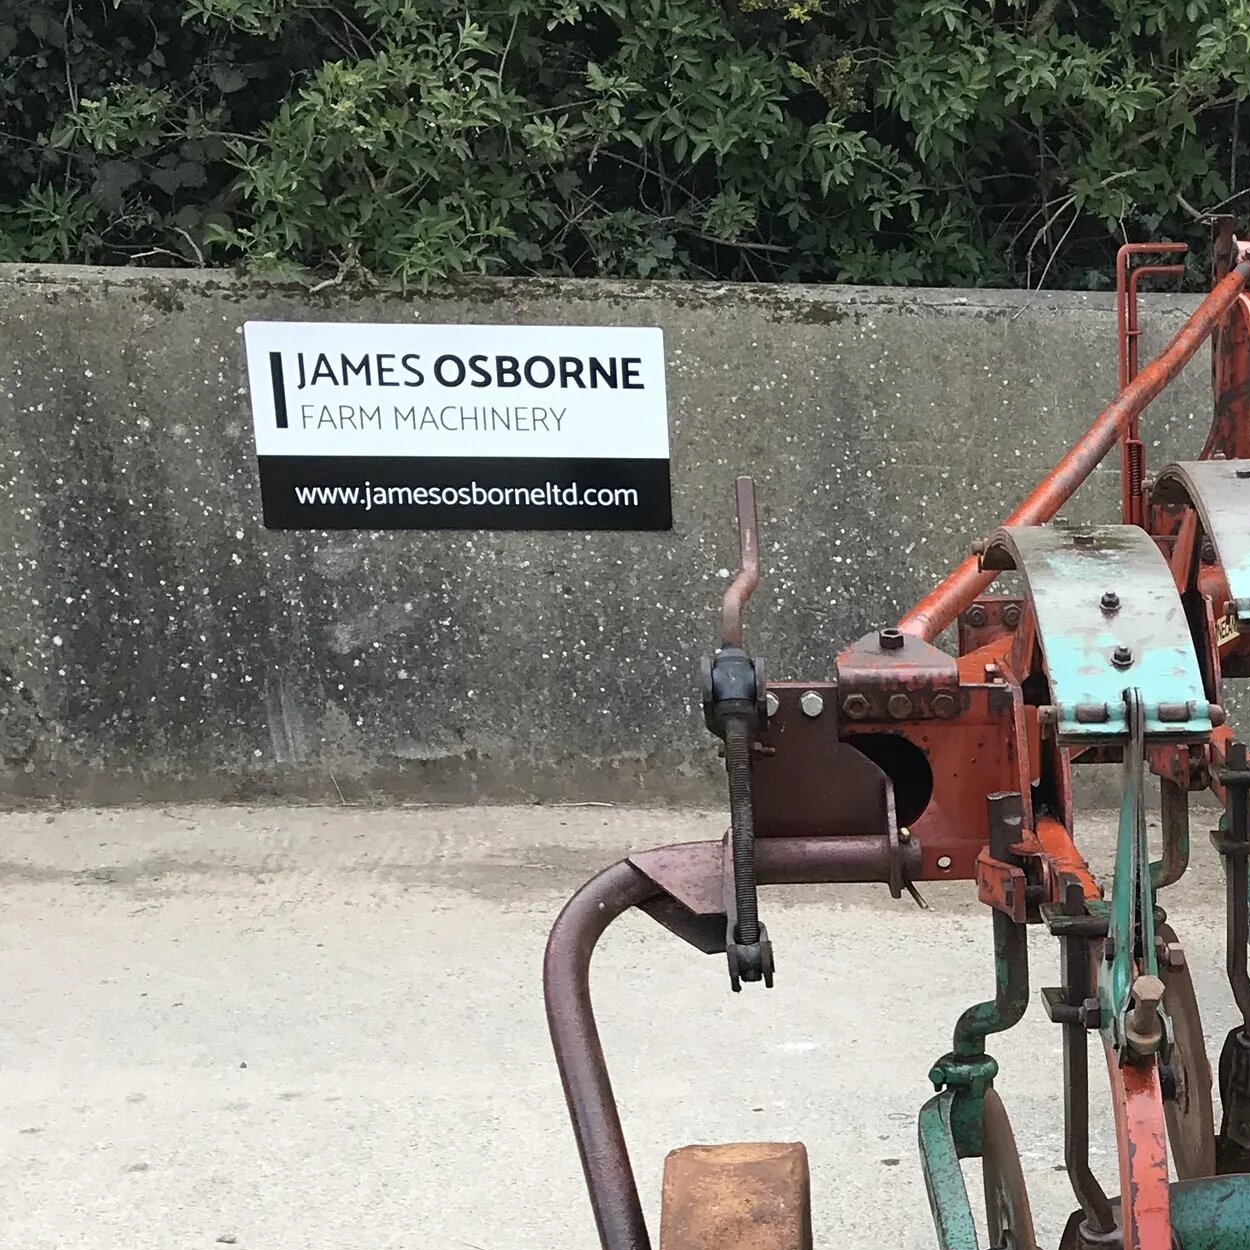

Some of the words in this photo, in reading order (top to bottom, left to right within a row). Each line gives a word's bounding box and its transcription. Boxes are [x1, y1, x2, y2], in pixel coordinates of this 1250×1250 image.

[297, 352, 425, 389] JAMES
[433, 354, 645, 390] OSBORNE
[302, 404, 382, 430] FARM
[394, 405, 567, 432] MACHINERY
[294, 481, 639, 511] www.jamesosborneltd.com
